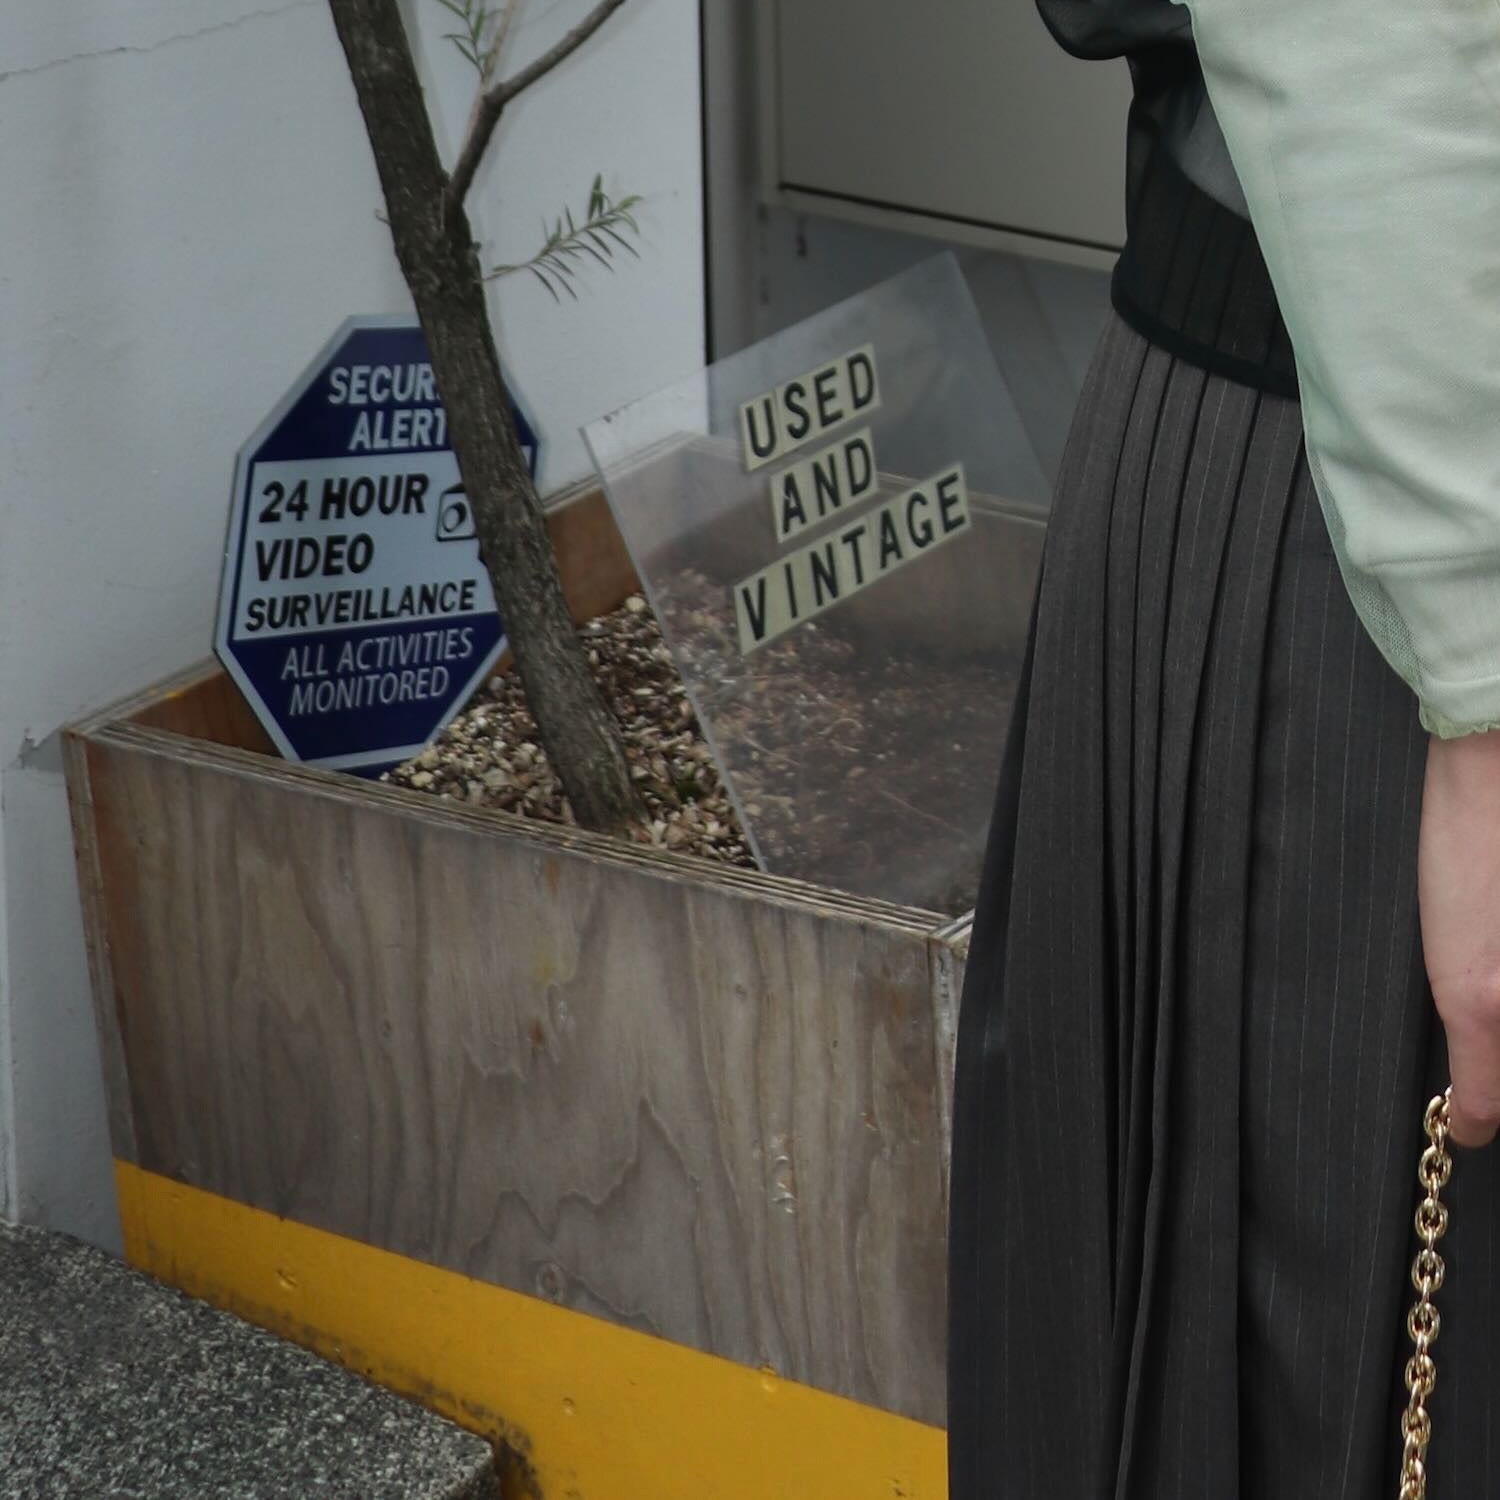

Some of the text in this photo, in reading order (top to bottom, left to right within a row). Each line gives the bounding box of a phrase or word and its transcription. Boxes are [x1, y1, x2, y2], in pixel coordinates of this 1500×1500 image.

[328, 362, 442, 405] SECUR
[745, 352, 875, 458] USED
[258, 473, 429, 524] 24 HOUR
[782, 437, 872, 534] AND
[255, 532, 374, 582] VIDEO
[741, 472, 967, 642] VINTAGE
[244, 579, 477, 632] SURVEILLANCE
[281, 627, 475, 681] ALL ACTIVITIES
[289, 665, 450, 717] MONITORED
